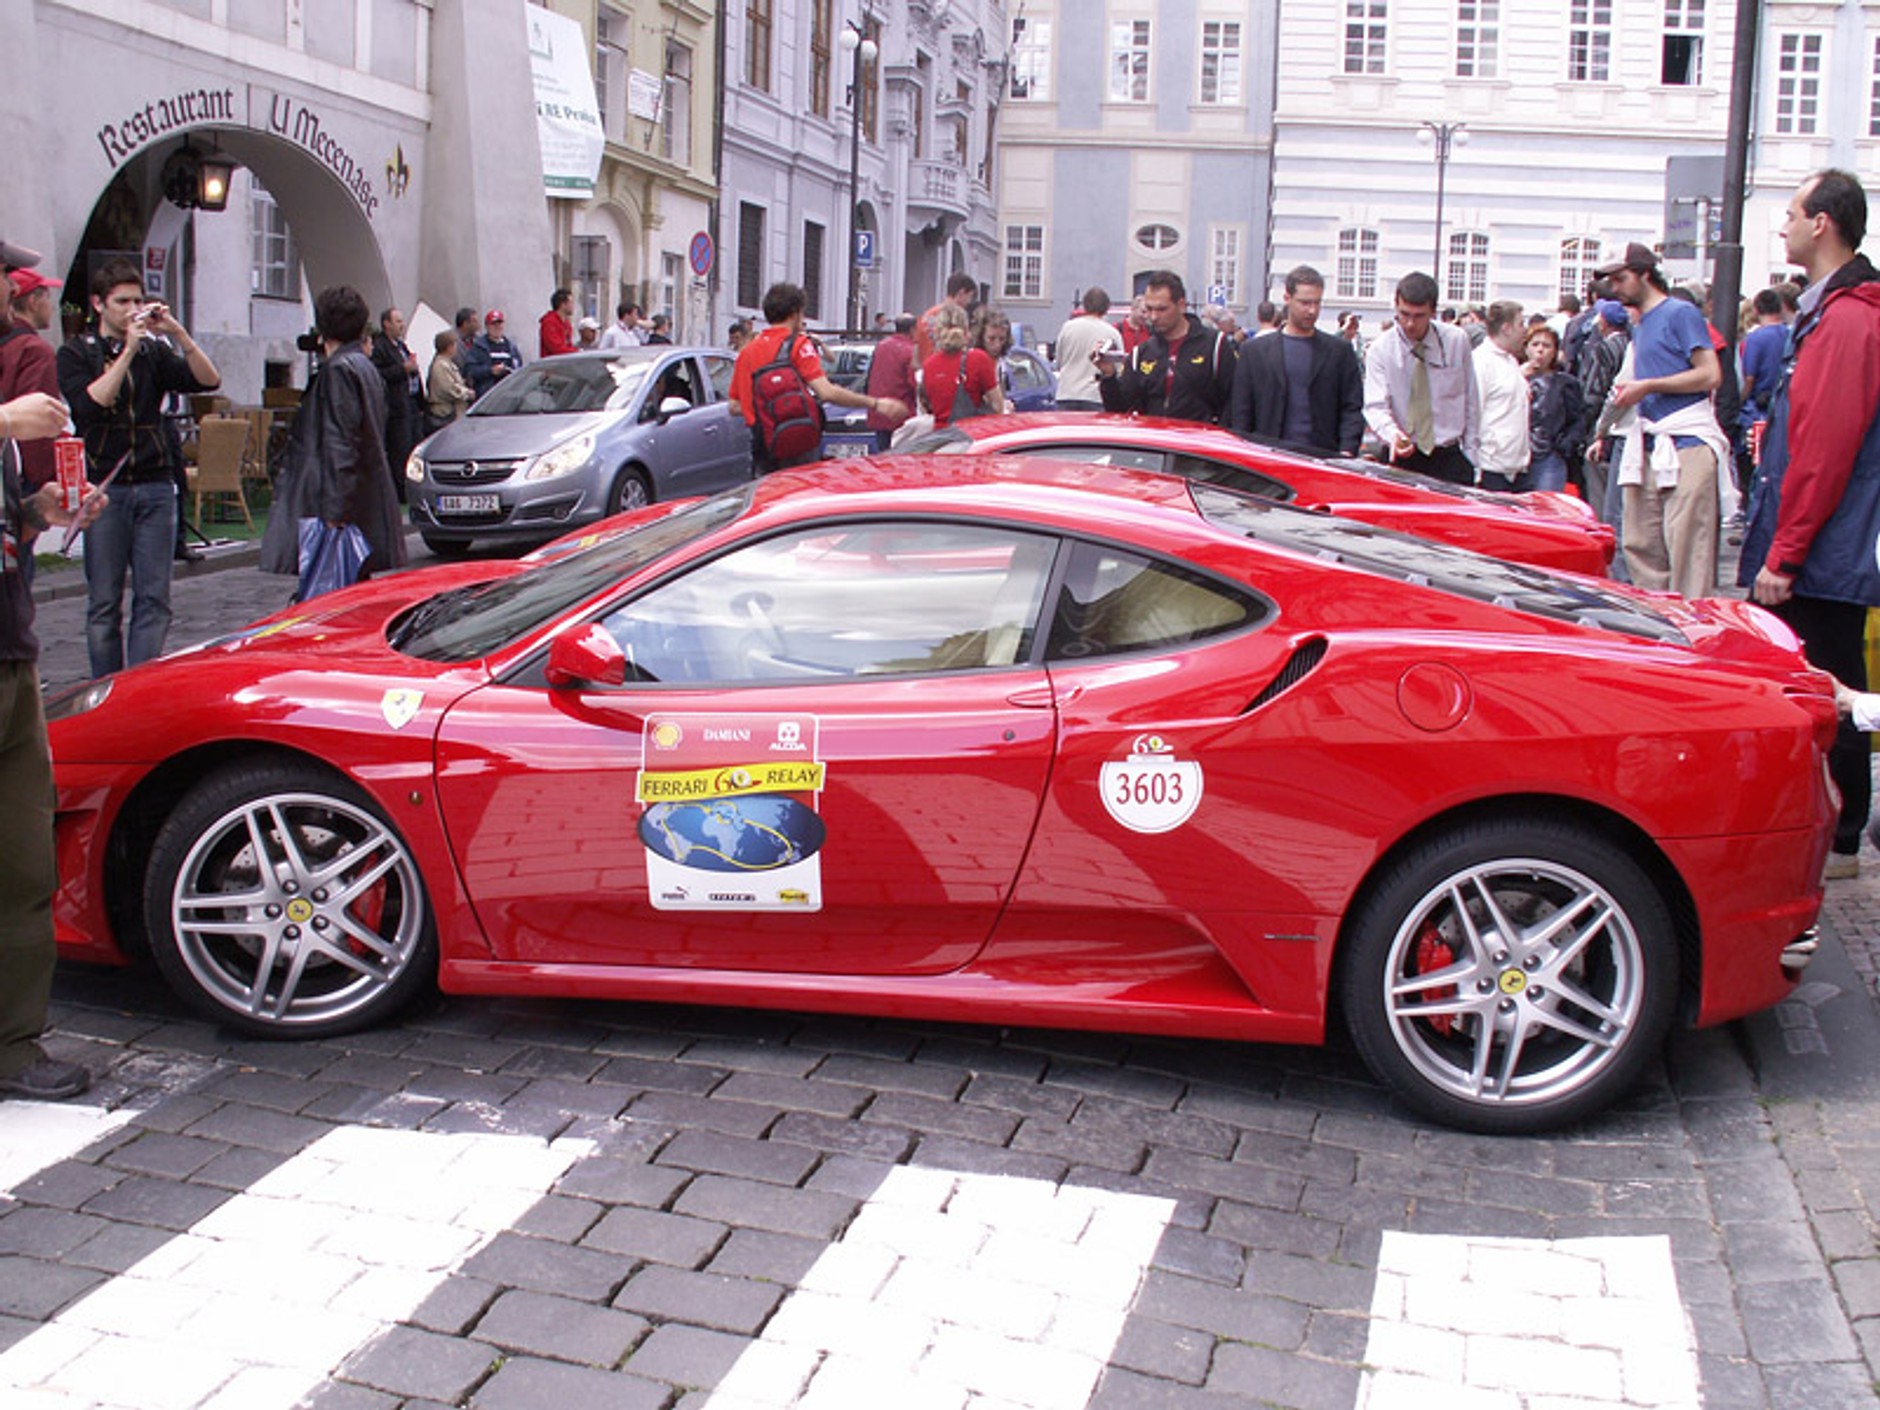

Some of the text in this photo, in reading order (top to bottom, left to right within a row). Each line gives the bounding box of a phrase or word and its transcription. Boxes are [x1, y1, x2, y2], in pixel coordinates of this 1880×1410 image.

[97, 87, 234, 168] Restaurant
[270, 93, 291, 133] U
[858, 234, 869, 254] P
[703, 729, 751, 741] DAMIANI
[769, 742, 807, 751] ALCOA
[643, 779, 709, 796] FERRARI
[766, 769, 819, 784] RELAY
[1116, 773, 1183, 805] 3603
